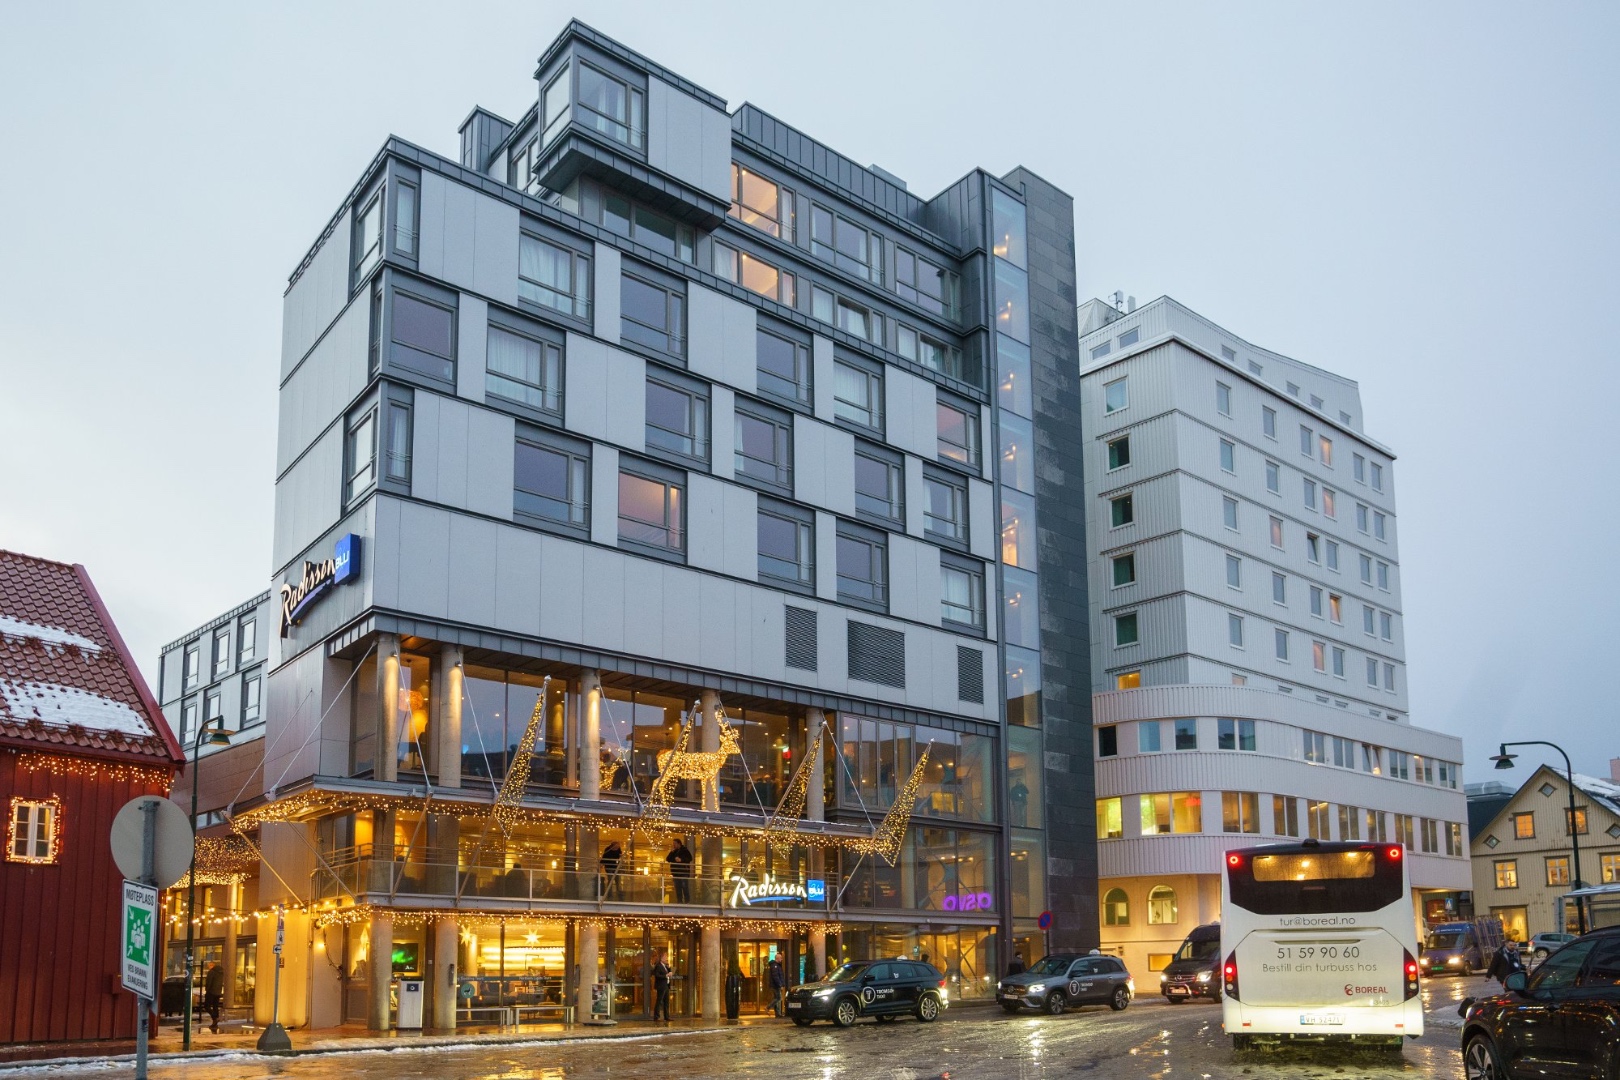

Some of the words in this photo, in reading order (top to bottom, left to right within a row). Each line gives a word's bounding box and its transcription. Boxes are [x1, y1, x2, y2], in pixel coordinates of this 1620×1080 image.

[280, 559, 336, 634] Radisson
[336, 551, 350, 570] BLU
[729, 873, 807, 908] Radisson
[126, 889, 154, 906] MØTEPLASS
[1280, 917, 1356, 926] tur@boreal.no
[1277, 947, 1292, 959] 51
[1299, 947, 1315, 959] 59
[1320, 946, 1337, 958] 90
[1343, 946, 1360, 958] 60
[1262, 963, 1292, 972] Bestill
[1295, 963, 1312, 972] din
[1316, 962, 1354, 972] turbuss
[1357, 962, 1377, 972] hos
[1355, 986, 1388, 994] BOREAL
